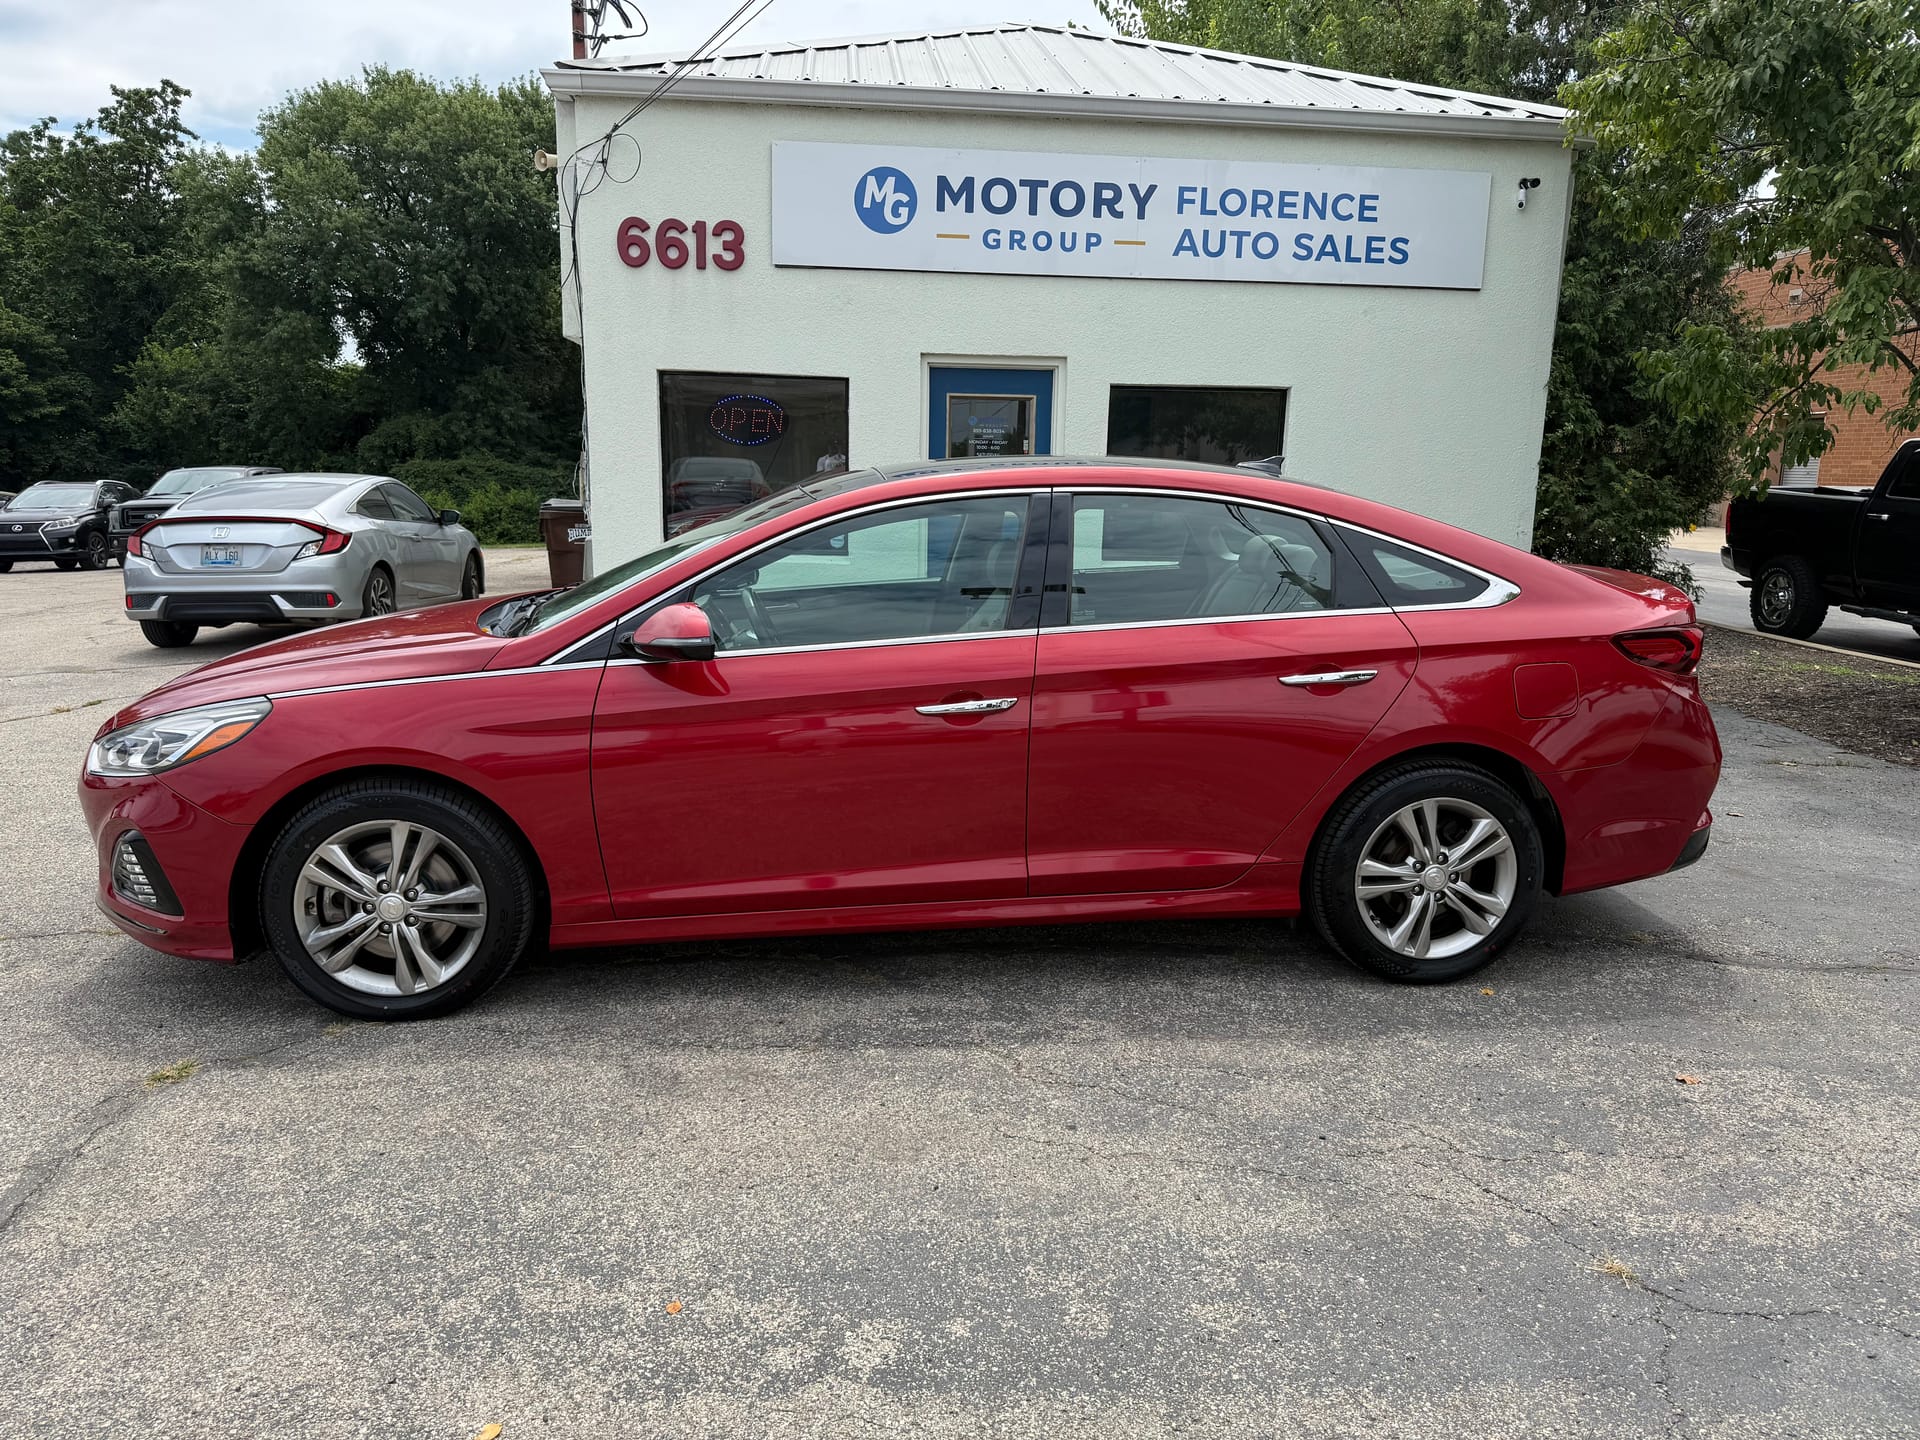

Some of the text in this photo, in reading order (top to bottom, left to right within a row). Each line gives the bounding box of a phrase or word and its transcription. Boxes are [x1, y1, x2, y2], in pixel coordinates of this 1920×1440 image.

[936, 175, 1158, 220] MOTORY
[1177, 186, 1380, 223] FLORENCE
[617, 216, 745, 271] 6613
[982, 228, 1102, 253] GROUP
[1172, 228, 1410, 265] AUTO SALES
[710, 407, 784, 434] OPEN
[204, 551, 218, 561] ALX
